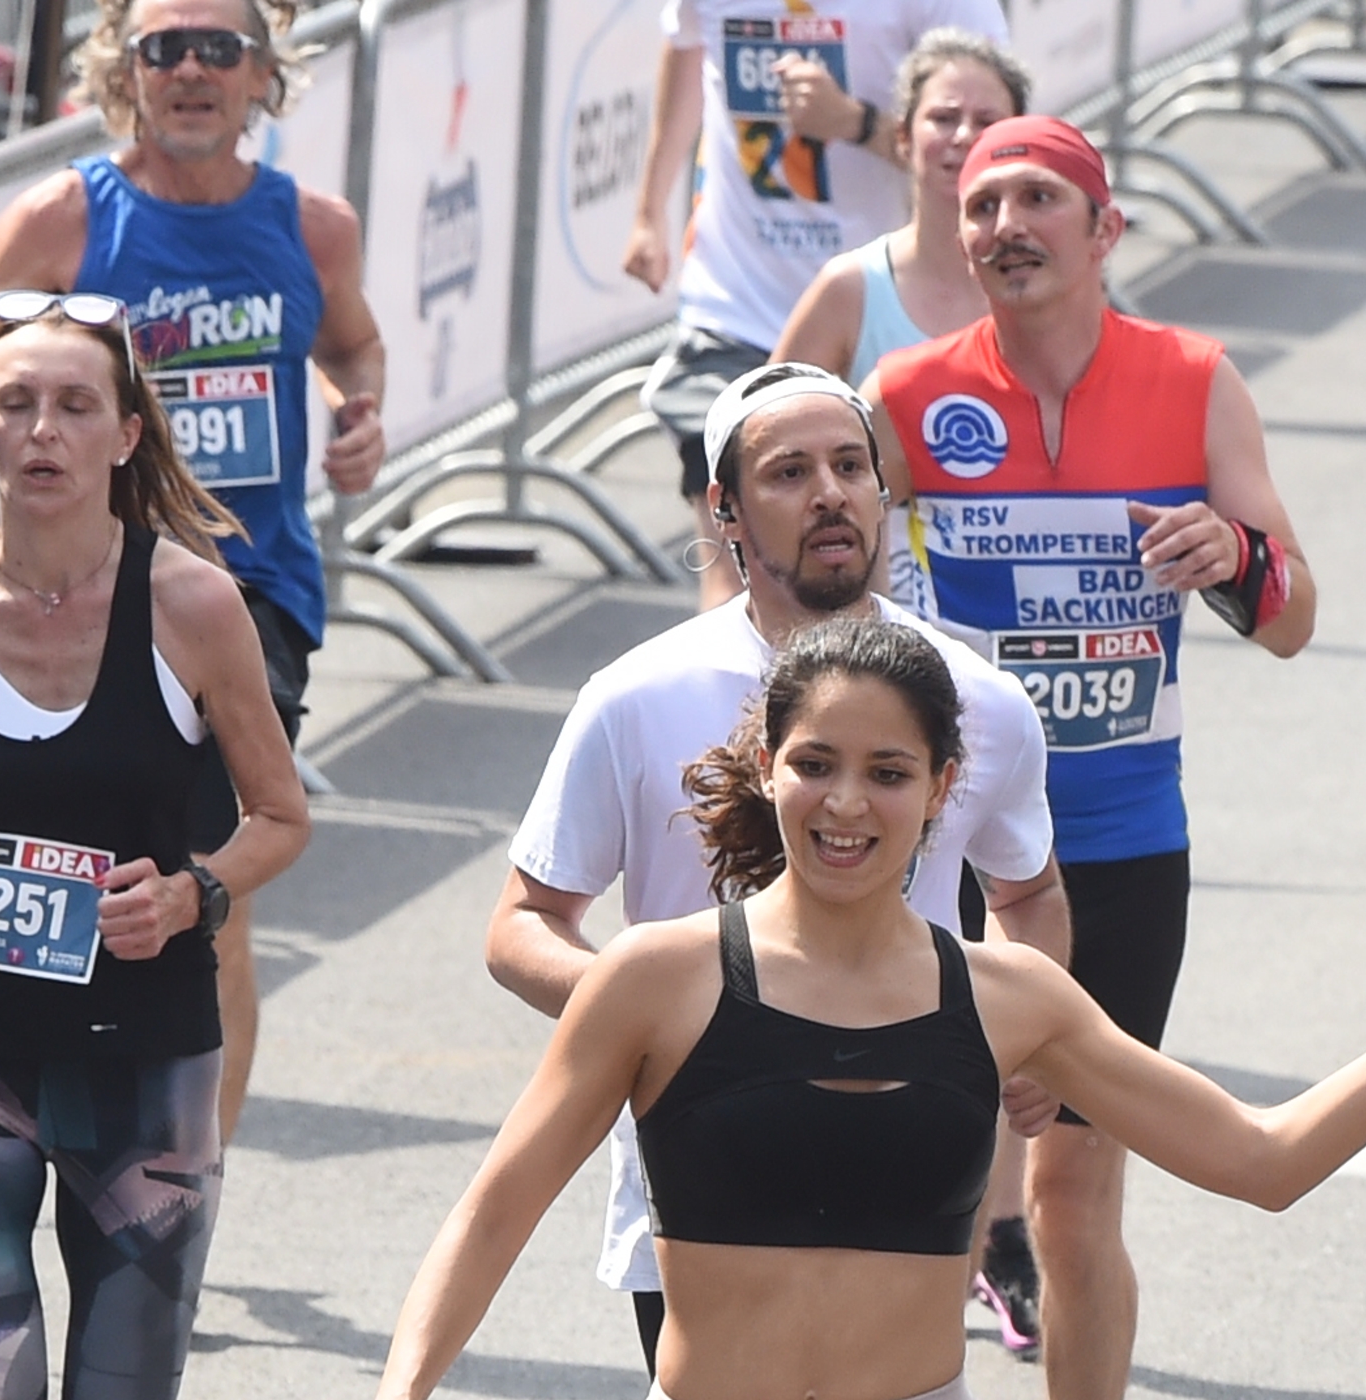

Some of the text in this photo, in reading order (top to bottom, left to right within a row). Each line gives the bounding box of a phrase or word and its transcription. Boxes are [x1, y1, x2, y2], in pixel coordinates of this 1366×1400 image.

[189, 293, 283, 348] RUN
[962, 506, 1009, 527] RSV
[962, 534, 1129, 555] TROMPETER
[1078, 569, 1145, 594] BAD
[1096, 633, 1152, 656] iDEA
[1024, 668, 1135, 720] 2039
[31, 846, 95, 878] iDEA
